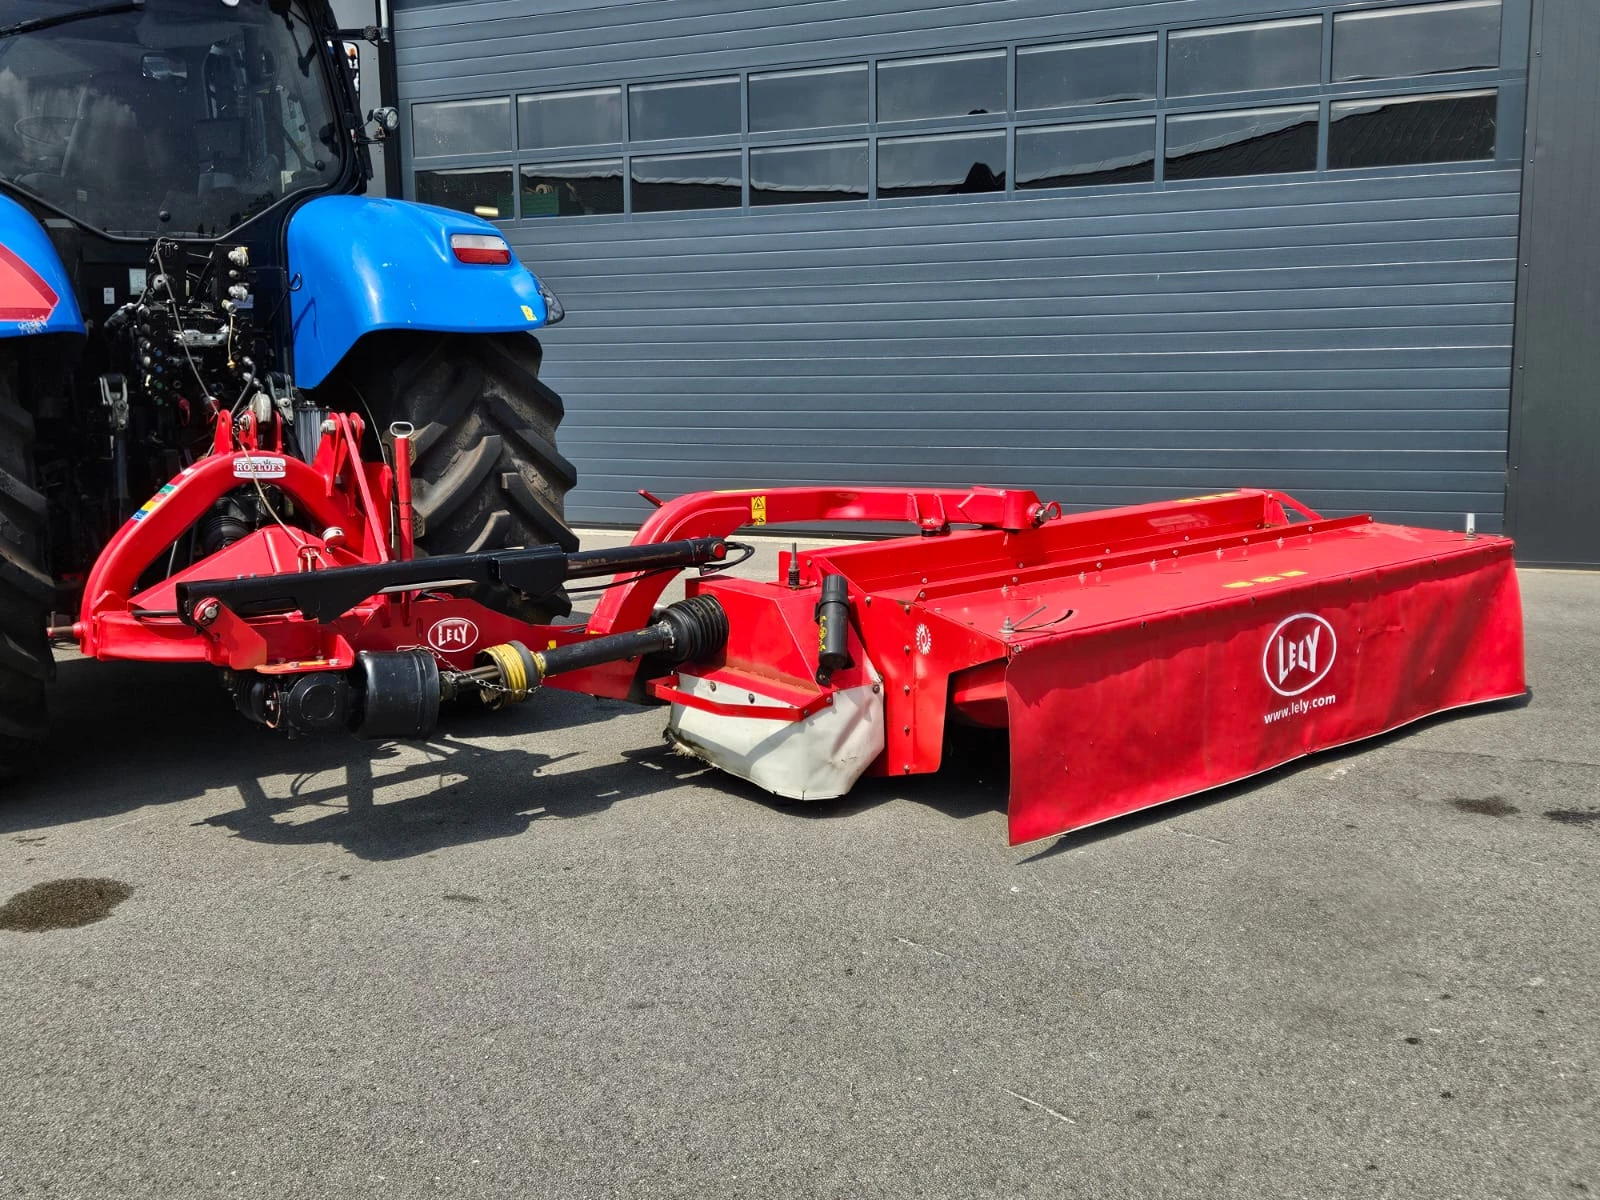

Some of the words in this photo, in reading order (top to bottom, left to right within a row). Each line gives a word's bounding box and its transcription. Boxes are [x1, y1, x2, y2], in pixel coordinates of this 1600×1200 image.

[438, 623, 468, 647] LELY
[1278, 624, 1321, 685] LELY
[1263, 694, 1336, 724] www.lely.com
